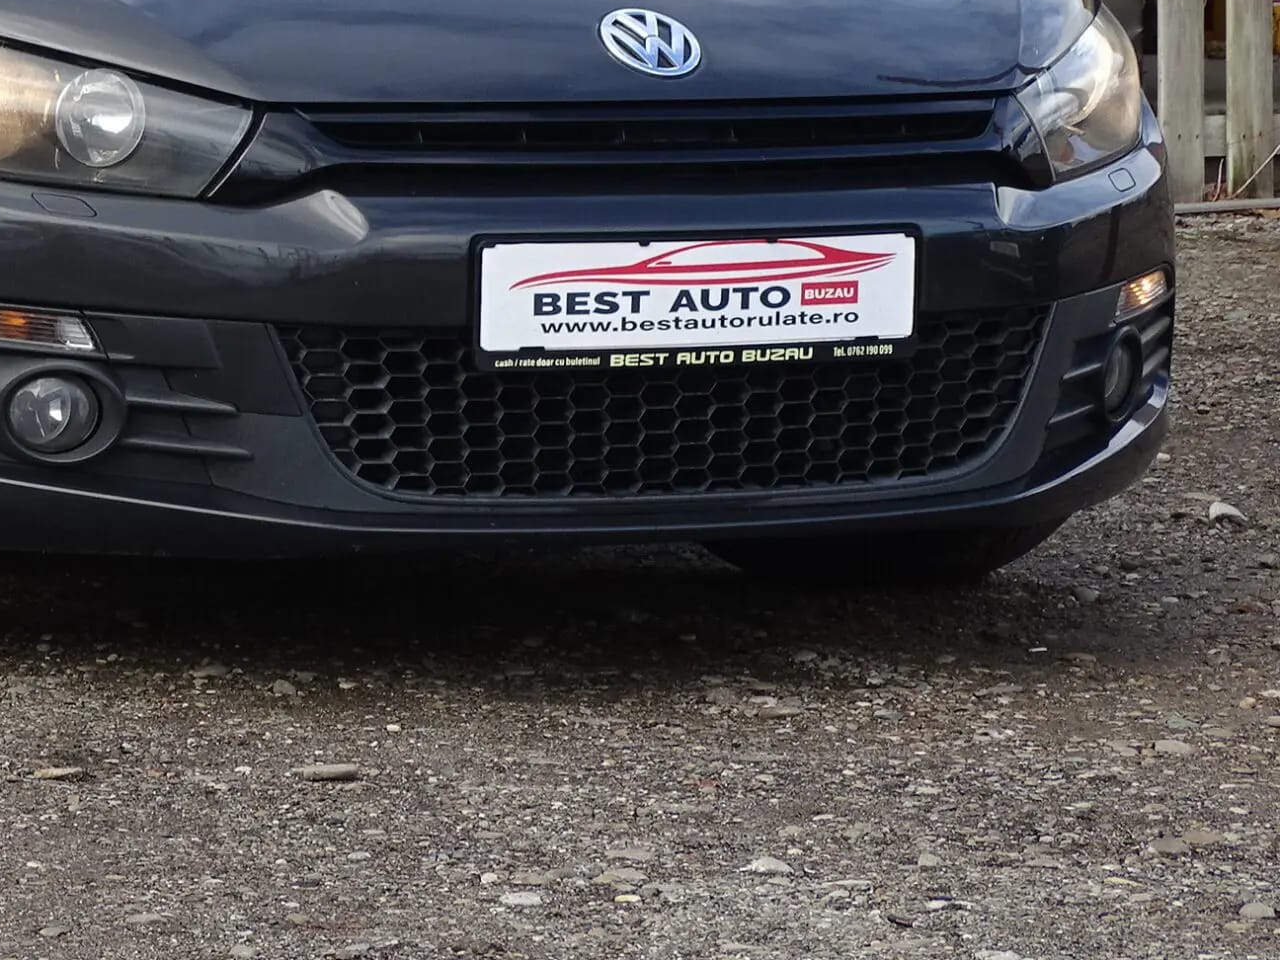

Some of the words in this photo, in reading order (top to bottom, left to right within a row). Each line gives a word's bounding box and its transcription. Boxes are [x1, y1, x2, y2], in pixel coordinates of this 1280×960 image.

[533, 290, 650, 316] BEST
[669, 285, 791, 313] AUTO
[804, 286, 855, 300] BUZAU
[541, 311, 859, 334] www.bestautorulate.ro
[495, 356, 513, 368] cash
[555, 357, 565, 367] cu
[610, 353, 669, 367] BEST
[676, 350, 734, 365] AUTO
[742, 347, 813, 362] BUZAU
